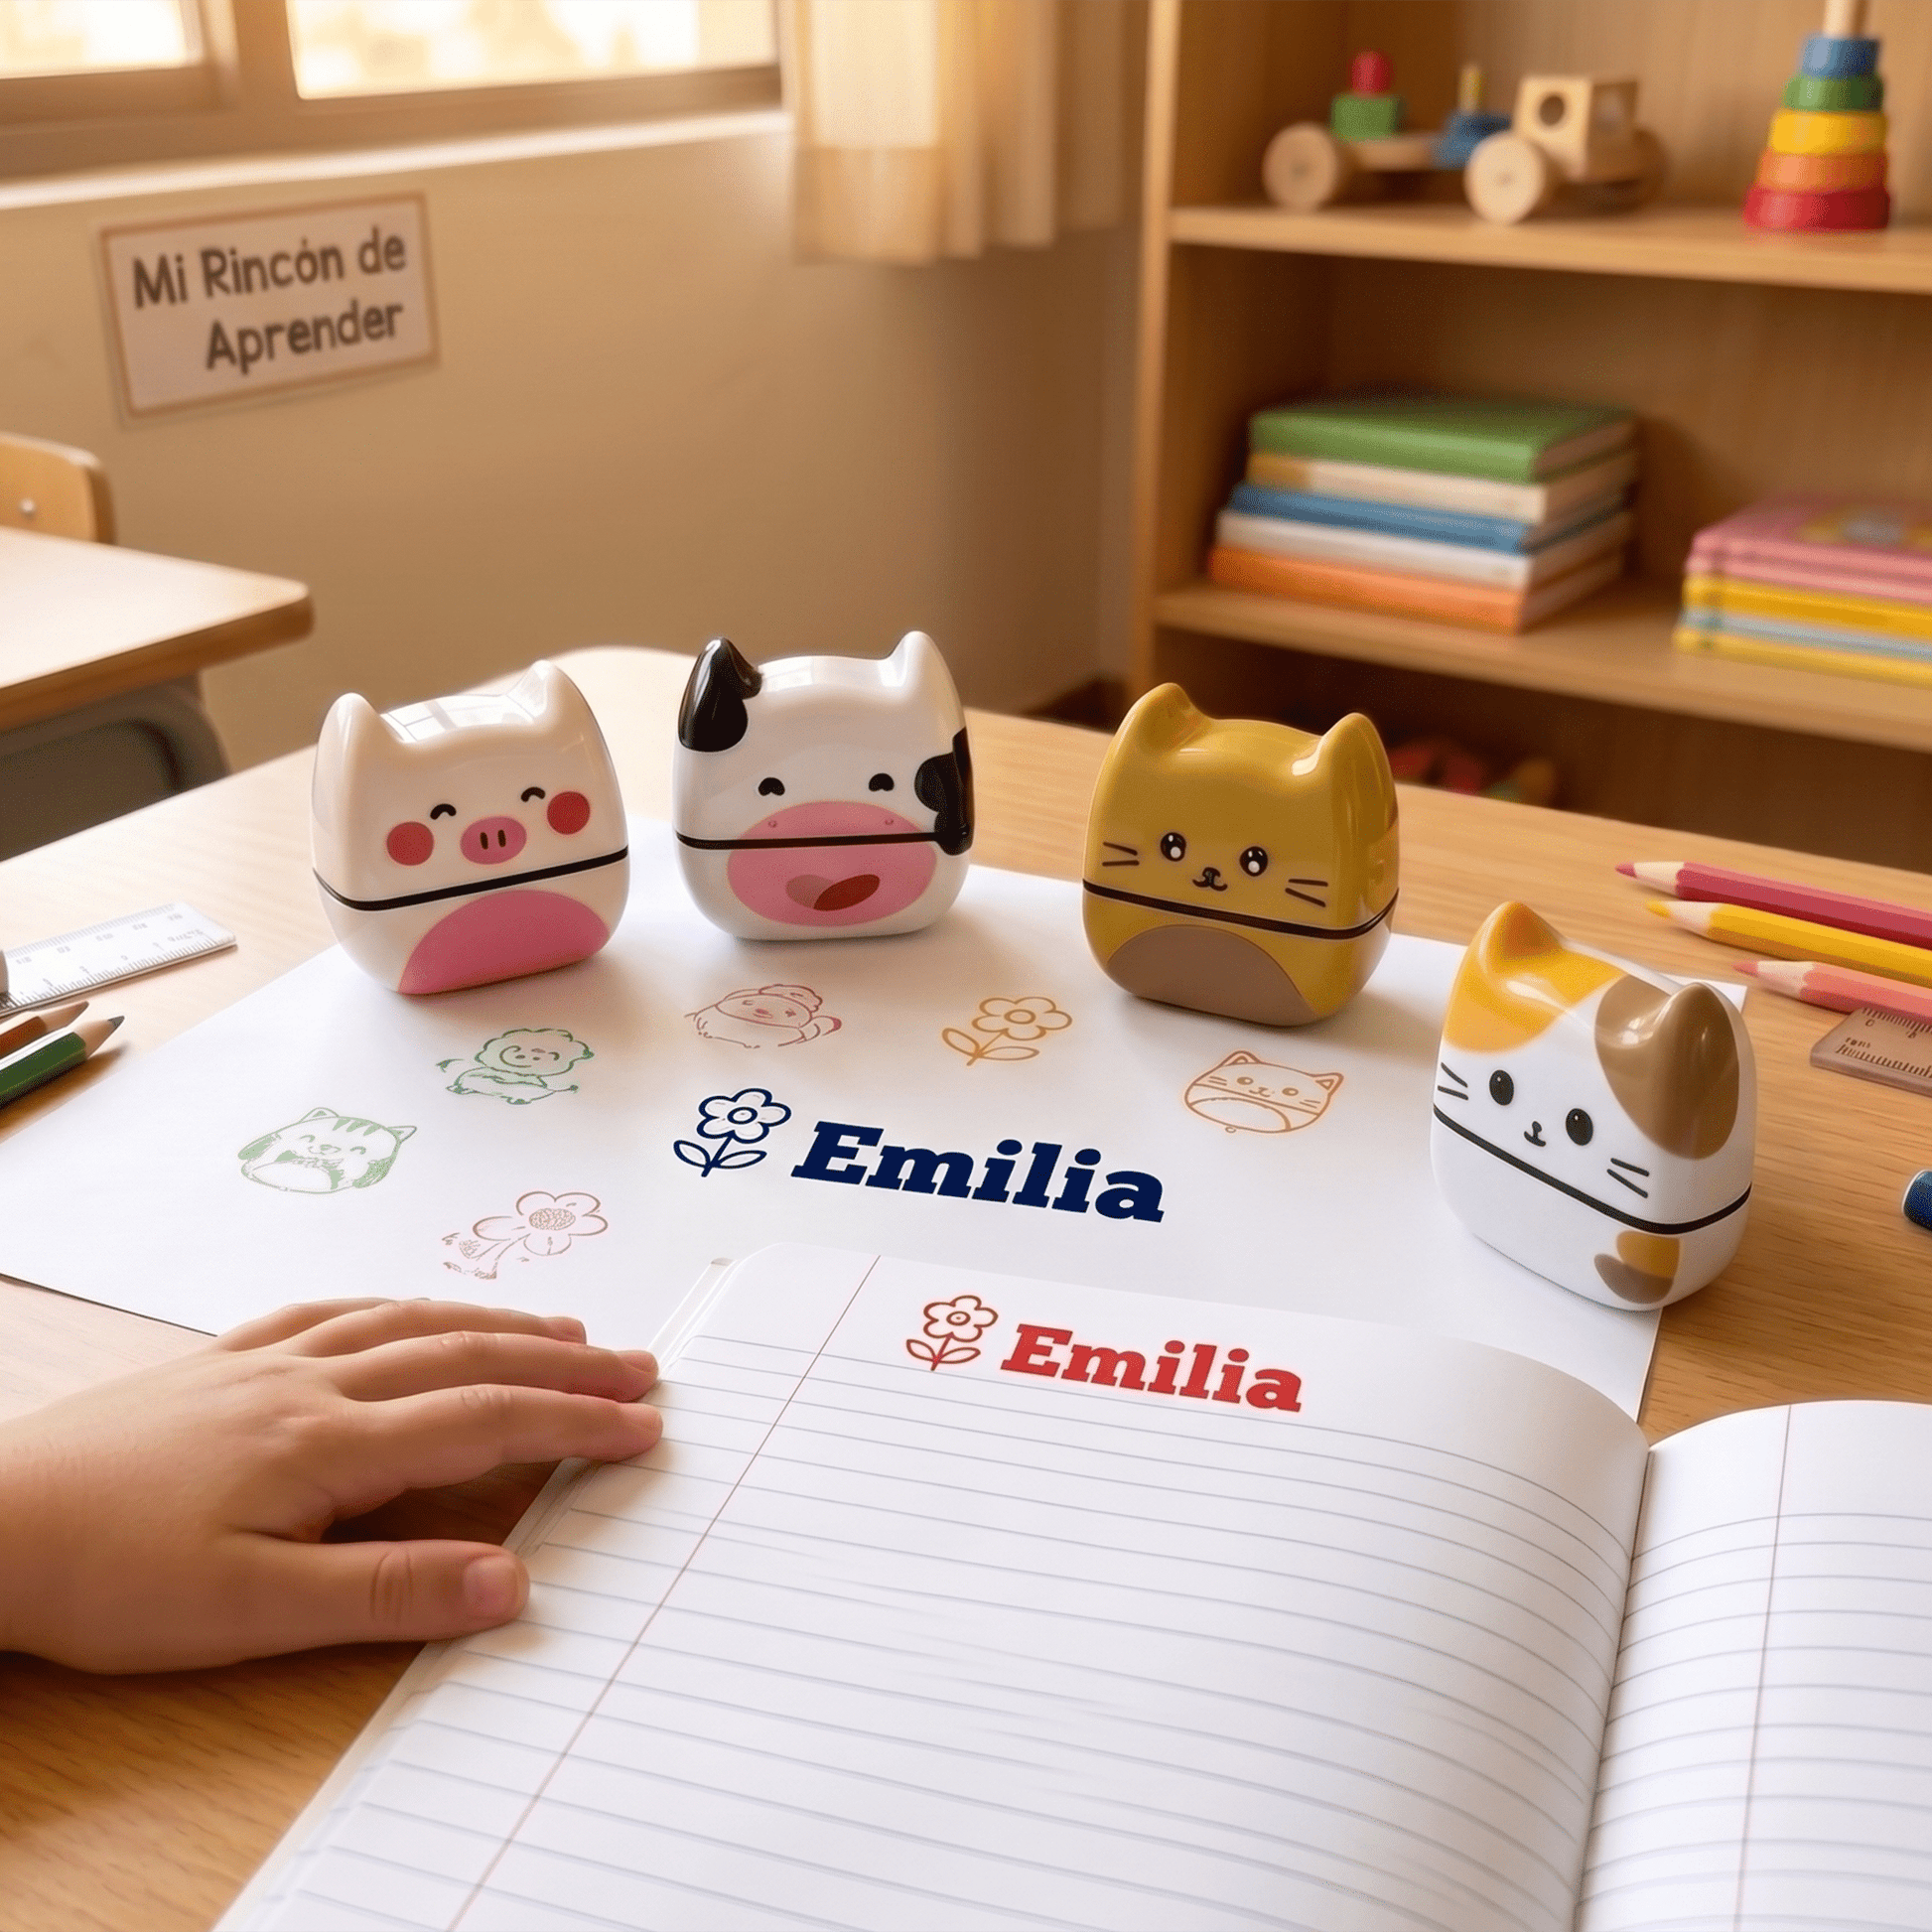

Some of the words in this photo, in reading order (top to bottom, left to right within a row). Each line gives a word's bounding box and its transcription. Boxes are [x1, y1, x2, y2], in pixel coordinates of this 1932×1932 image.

[133, 253, 189, 309] Mi
[201, 237, 345, 298] Rincón
[357, 225, 406, 275] de
[206, 298, 404, 376] Aprender
[790, 1120, 1165, 1223] Emilia
[1000, 1322, 1303, 1413] Emilia
